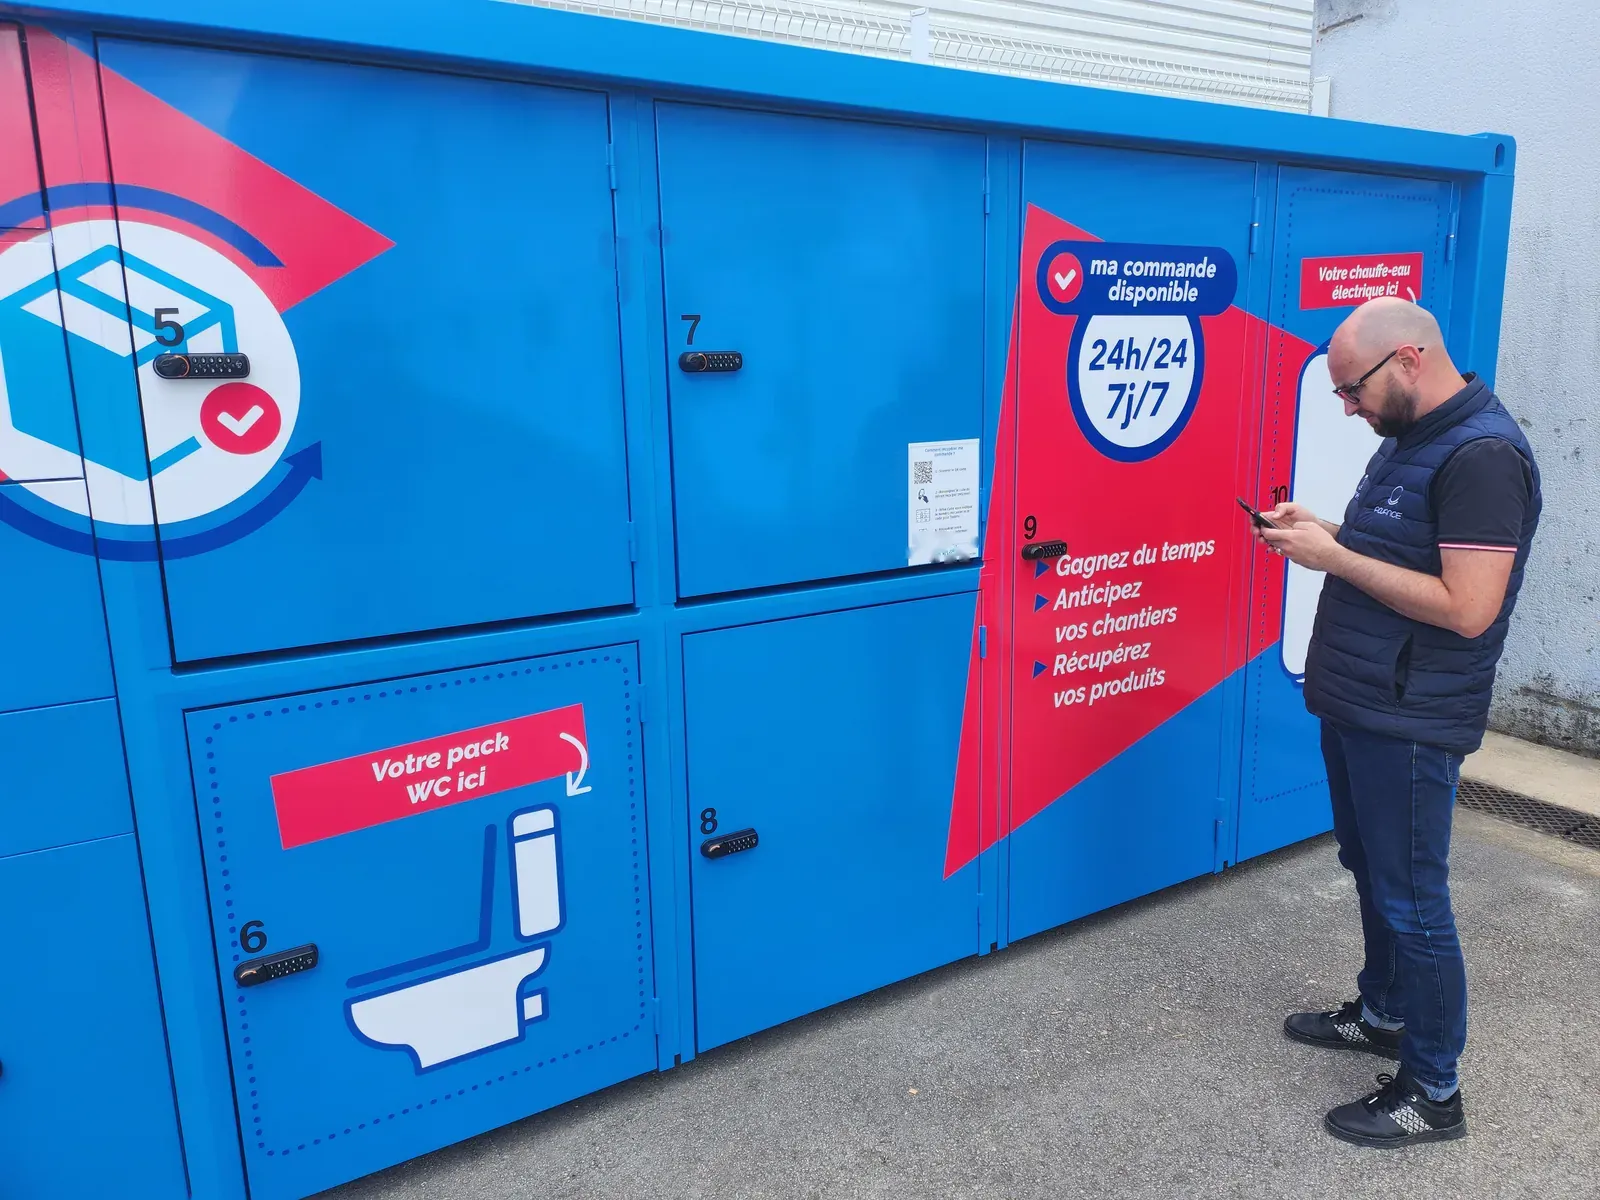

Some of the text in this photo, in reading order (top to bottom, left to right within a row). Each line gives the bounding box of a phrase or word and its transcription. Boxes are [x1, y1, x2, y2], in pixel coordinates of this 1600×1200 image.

[1090, 256, 1217, 278] ma commande
[1319, 263, 1411, 282] Votre chauffe-eau
[1108, 279, 1198, 307] disponible
[1332, 281, 1399, 300] électrique ici
[154, 308, 184, 347] 5
[681, 315, 701, 345] 7
[1088, 337, 1188, 371] 24h/24
[1106, 380, 1170, 430] 7j/7
[1271, 485, 1288, 506] 10
[1024, 515, 1037, 540] 9
[1056, 539, 1215, 579] Gagnez du temps
[1053, 581, 1142, 611] Anticipez
[1055, 606, 1178, 643] vos chantiers
[1052, 642, 1151, 676] Récupérez
[1054, 667, 1165, 708] vos produits
[371, 731, 509, 782] Votre pack
[406, 766, 487, 804] WC ici
[700, 807, 718, 835] 8
[240, 920, 267, 953] 6
